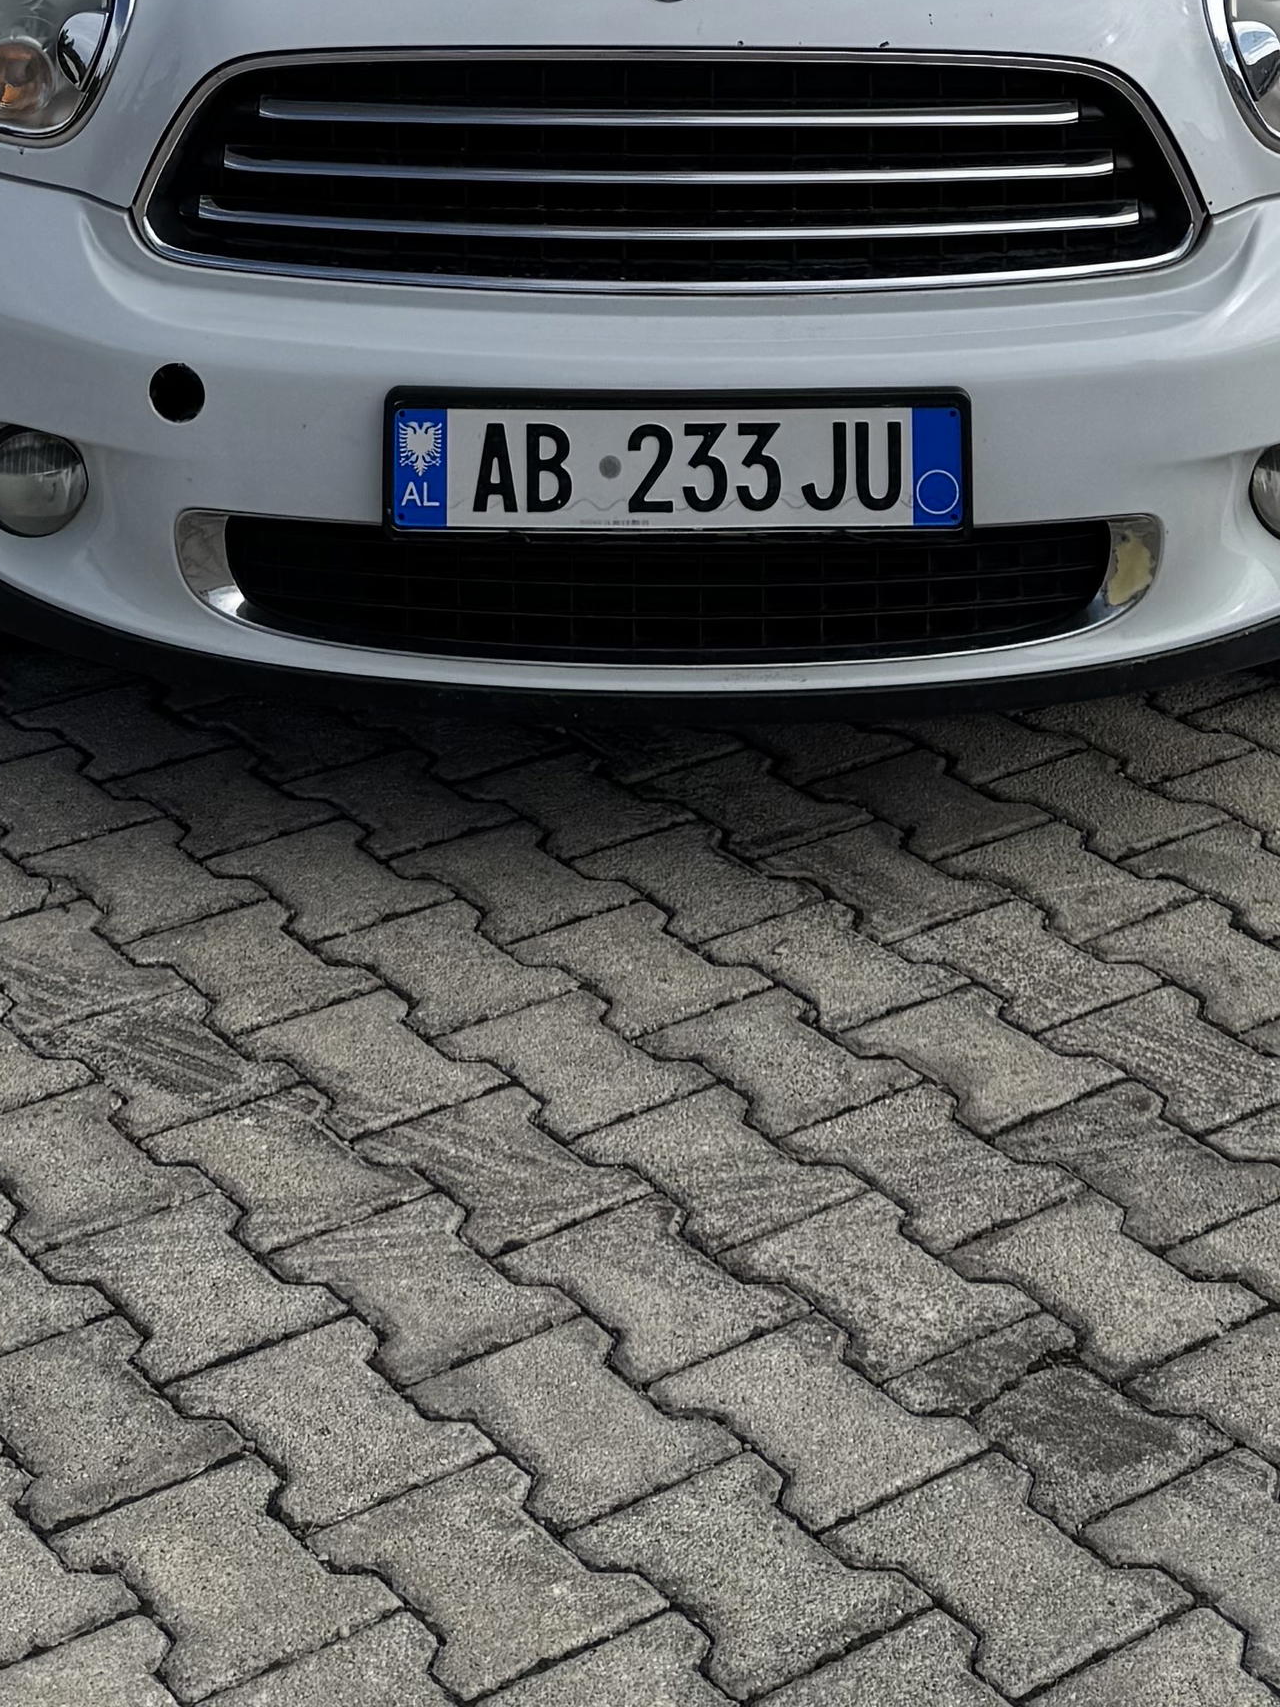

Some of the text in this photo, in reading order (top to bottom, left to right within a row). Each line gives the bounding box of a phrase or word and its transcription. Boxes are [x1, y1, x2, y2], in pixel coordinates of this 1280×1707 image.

[401, 481, 440, 507] AL
[472, 421, 903, 513] AB 233 JU
